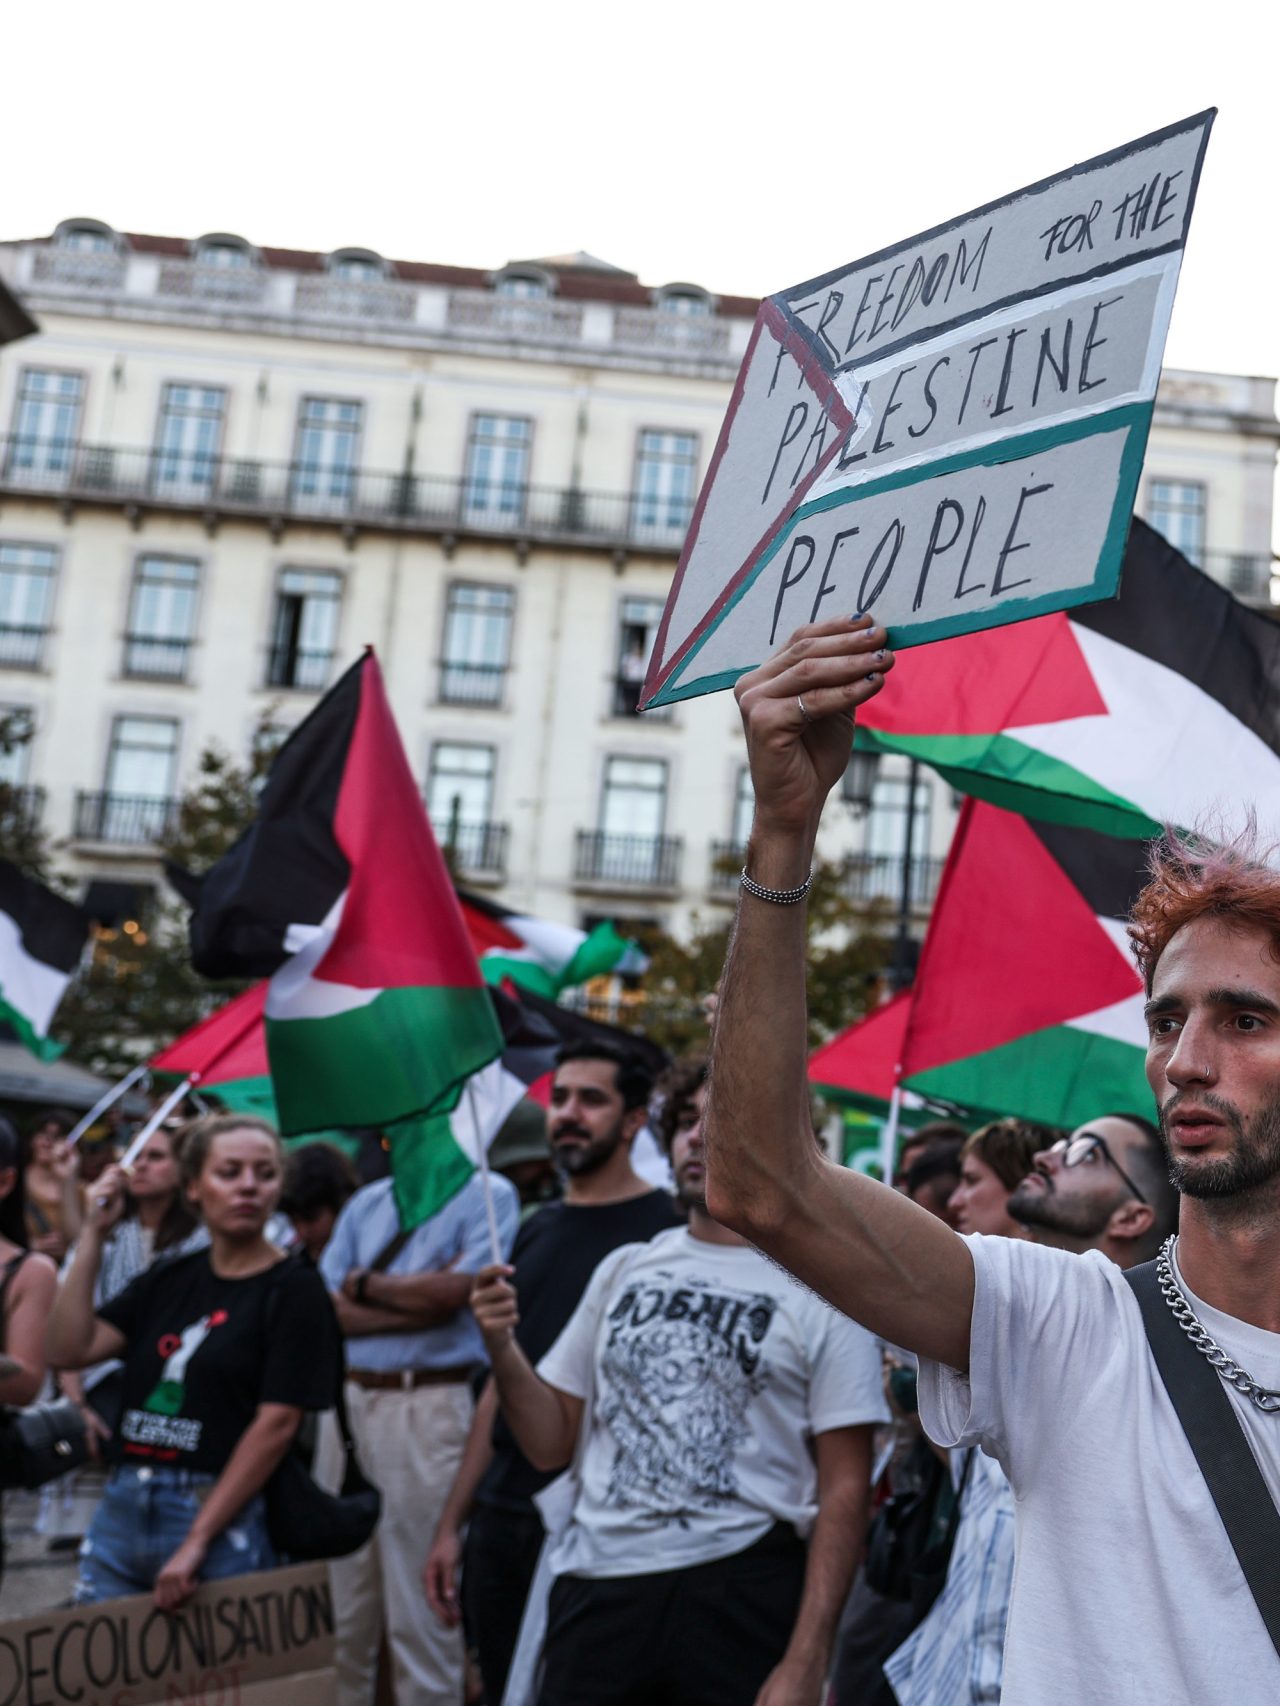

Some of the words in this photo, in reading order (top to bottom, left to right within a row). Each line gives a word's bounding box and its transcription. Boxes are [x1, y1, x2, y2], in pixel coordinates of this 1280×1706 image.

[766, 225, 994, 397] FREEDOM
[1039, 199, 1104, 262] FOR
[1113, 170, 1184, 242] THE
[761, 294, 1124, 506] PALESTINE
[769, 482, 1055, 646] PEOPLE
[0, 1584, 335, 1706] DECOLONISATION
